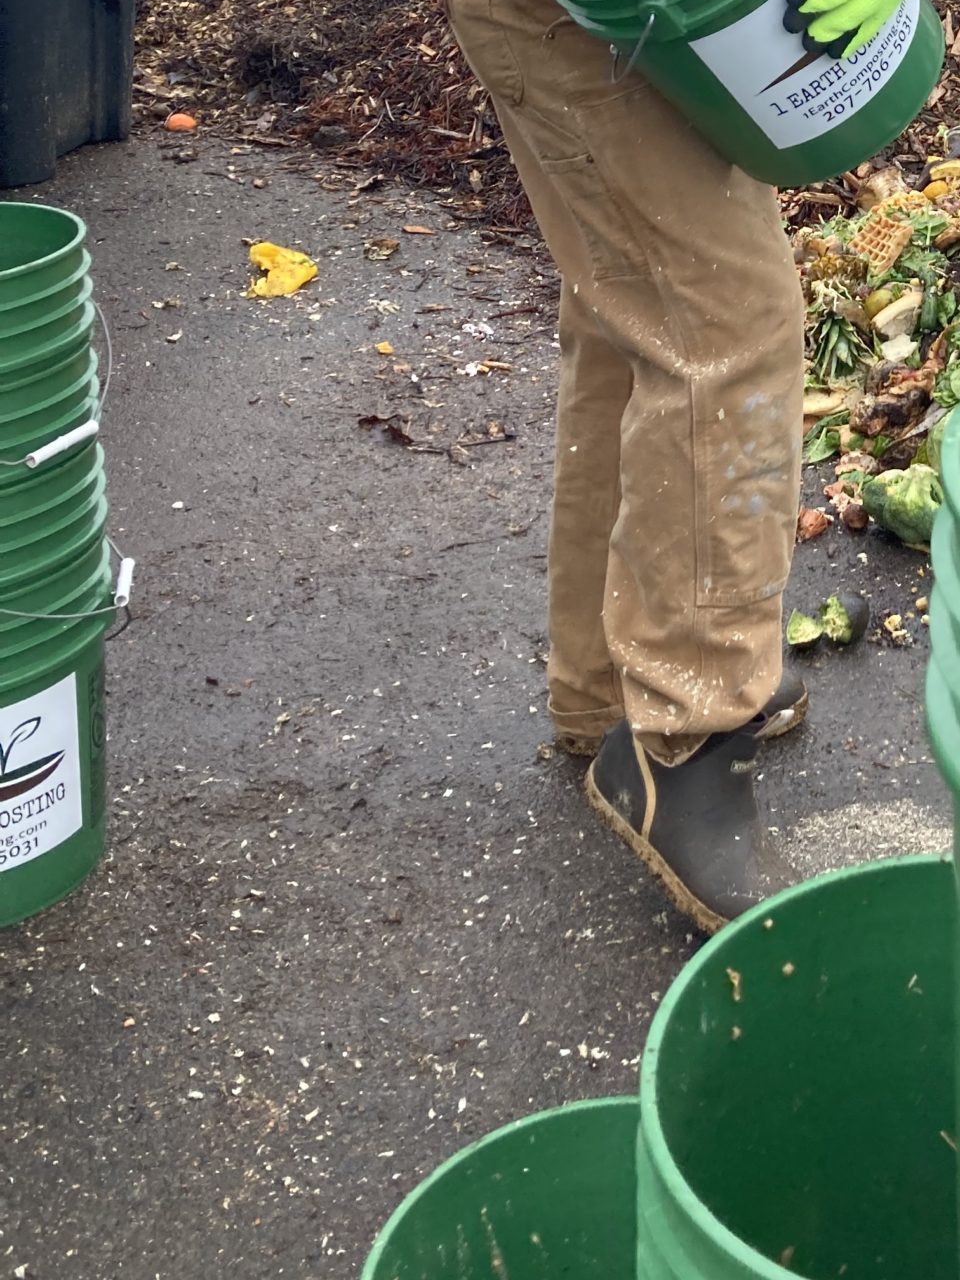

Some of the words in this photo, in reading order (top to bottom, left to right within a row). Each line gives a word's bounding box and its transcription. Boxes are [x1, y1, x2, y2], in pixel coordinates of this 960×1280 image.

[769, 102, 789, 117] 1
[786, 62, 848, 110] EARTH
[822, 14, 912, 122] 207-706-5031
